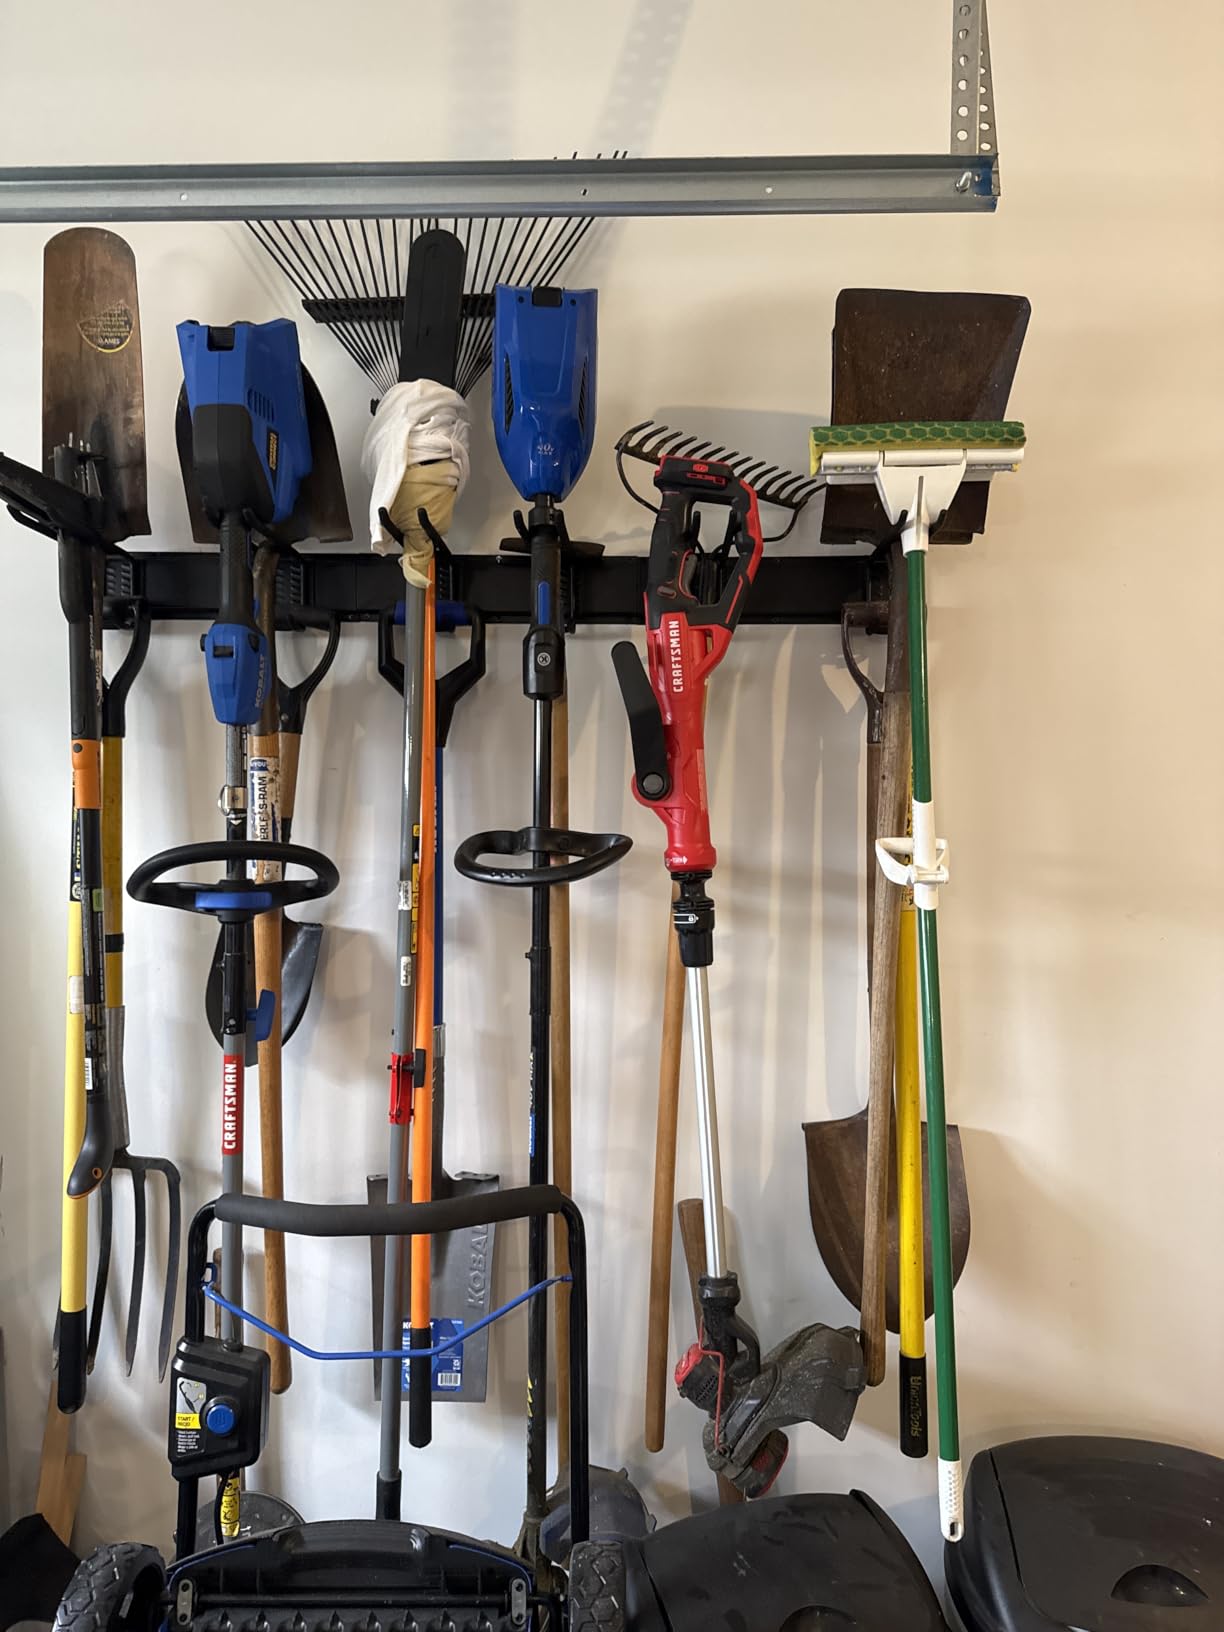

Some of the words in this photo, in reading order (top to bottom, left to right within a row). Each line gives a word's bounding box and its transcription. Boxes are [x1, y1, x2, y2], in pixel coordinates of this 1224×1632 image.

[669, 620, 684, 693] CRAFTSMAN
[224, 1063, 237, 1149] CRAFTSMAN
[466, 1223, 488, 1309] KOBAL
